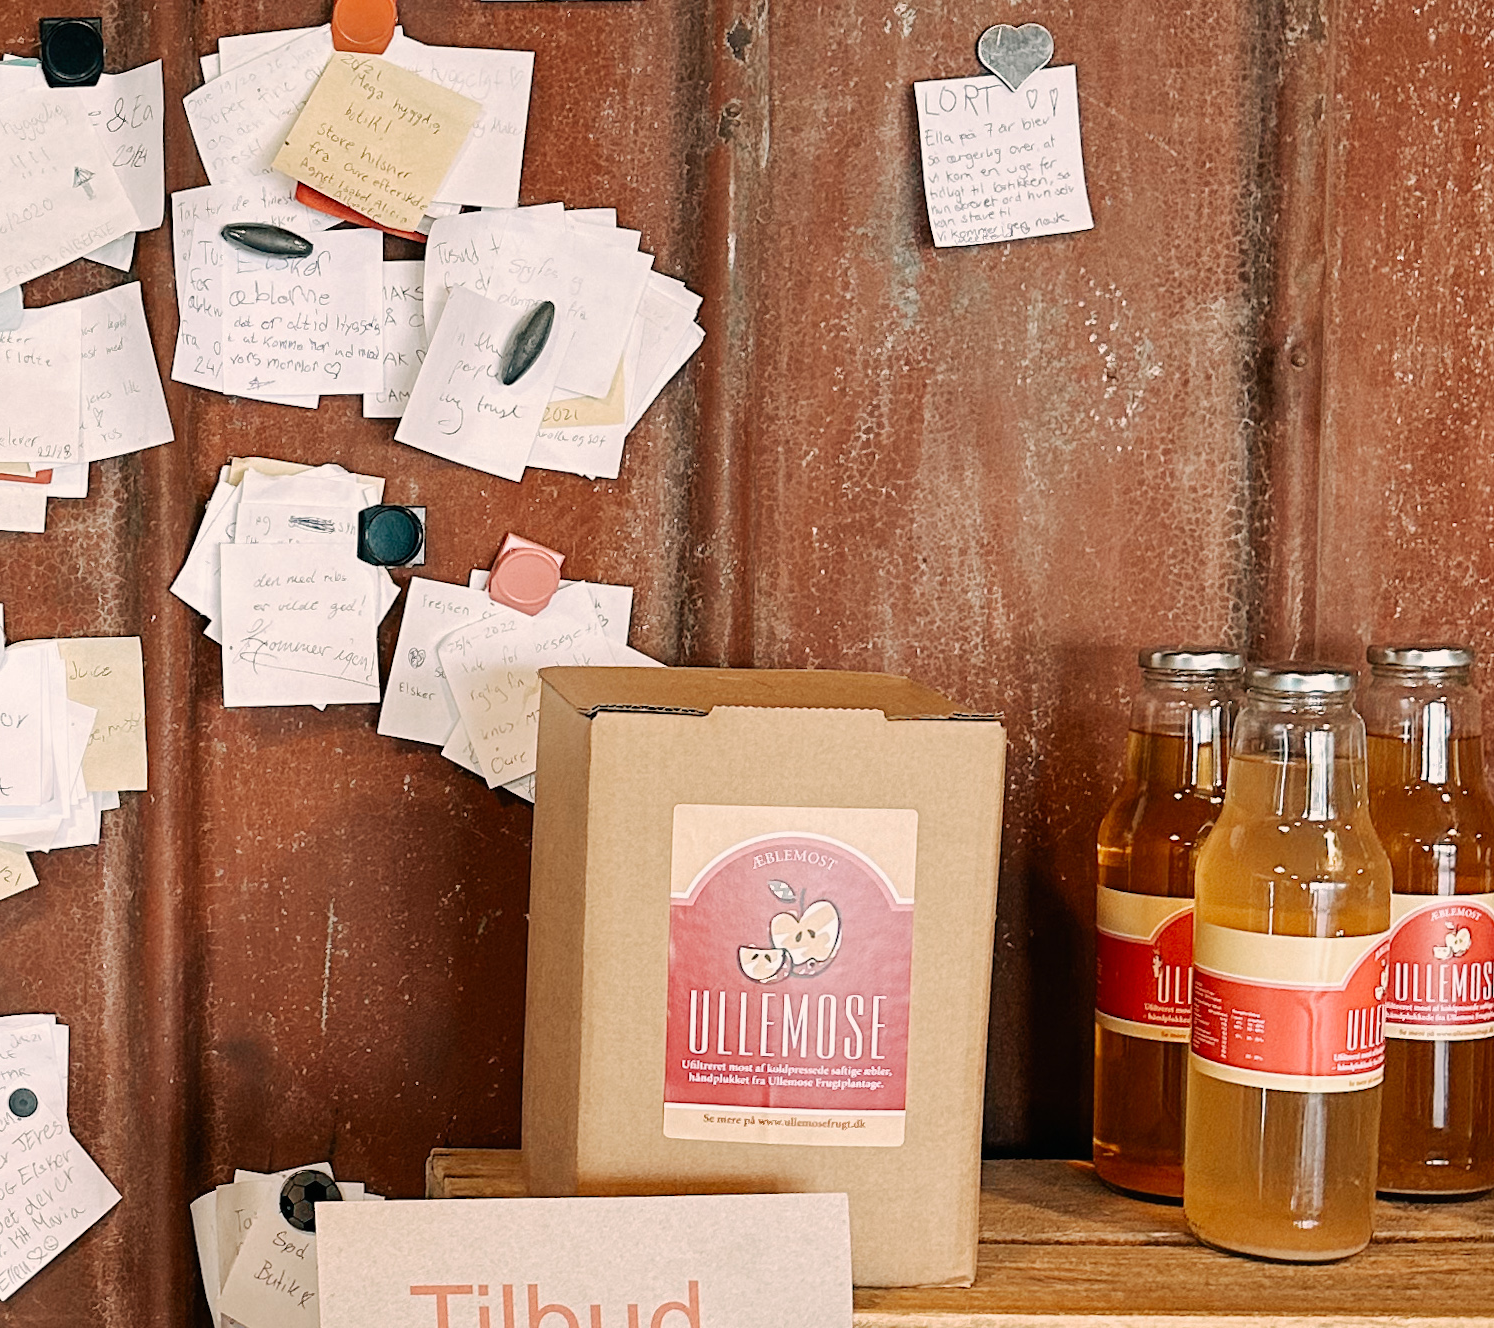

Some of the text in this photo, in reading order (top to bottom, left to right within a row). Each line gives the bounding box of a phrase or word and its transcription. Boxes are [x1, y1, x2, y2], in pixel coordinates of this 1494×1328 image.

[925, 84, 1003, 116] LORT
[925, 129, 954, 147] Ella
[984, 123, 993, 137] 7
[1043, 135, 1057, 149] at
[750, 847, 839, 872] ÆBLEMOST
[1430, 907, 1483, 922] ÆBLEMOST
[1394, 961, 1494, 1003] ULLEMOS
[688, 988, 887, 1062] ULLEMOSE
[1347, 1004, 1385, 1051] ULLE
[688, 1072, 750, 1086] håndplukket
[751, 1076, 766, 1086] fra
[768, 1076, 814, 1087] Ullemose
[729, 1063, 753, 1072] most
[755, 1063, 766, 1073] af
[767, 1064, 829, 1076] koldpressede
[830, 1066, 862, 1078] saftige
[703, 1113, 866, 1131] Se mere på www.ullemosefrugt.dk
